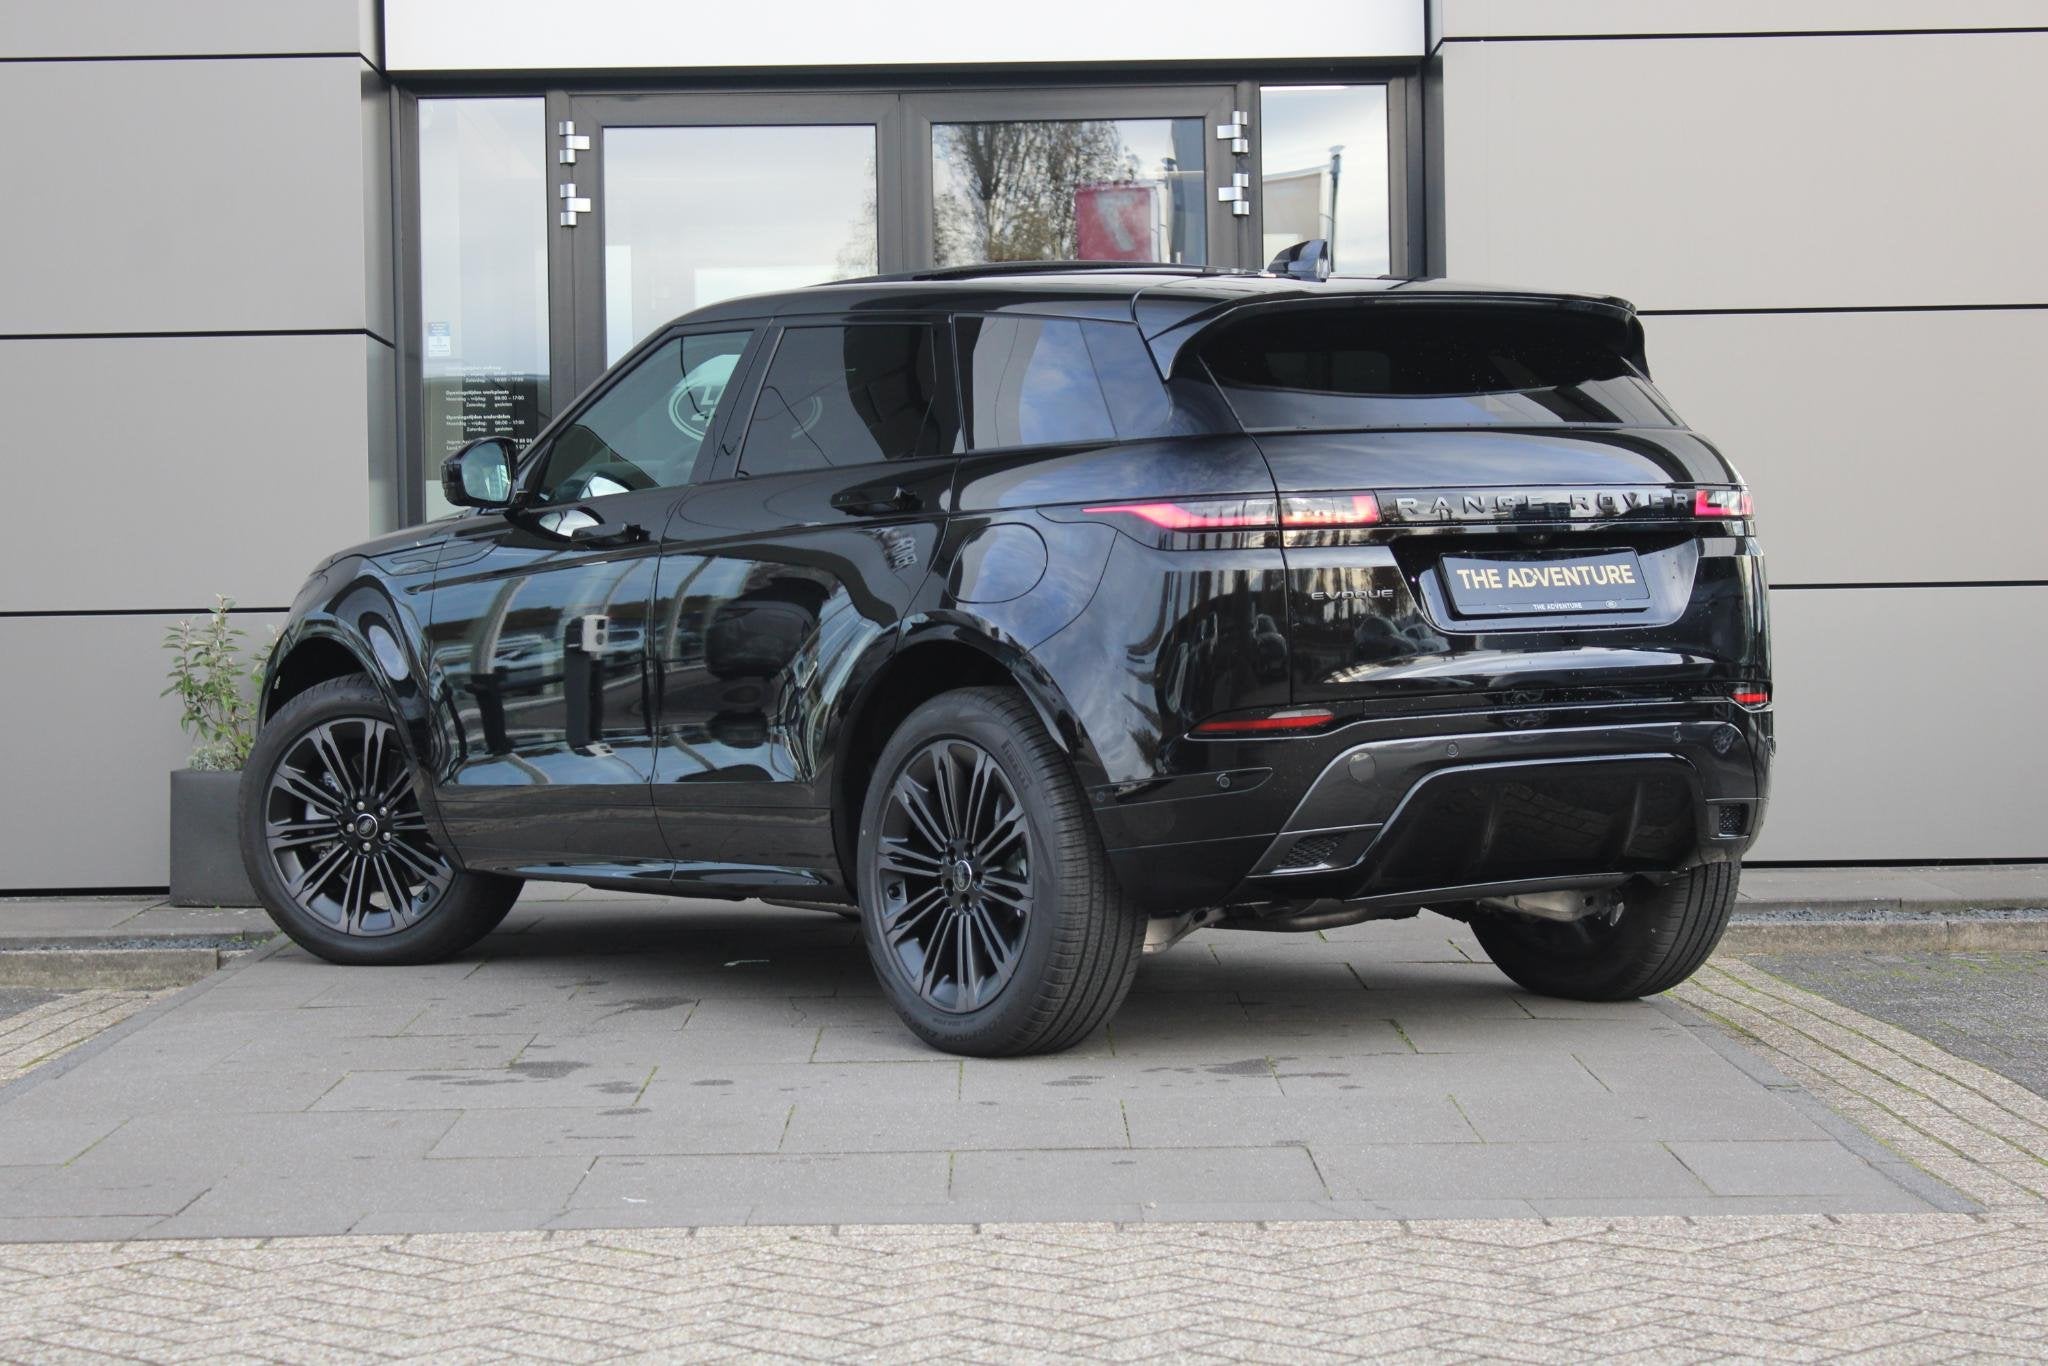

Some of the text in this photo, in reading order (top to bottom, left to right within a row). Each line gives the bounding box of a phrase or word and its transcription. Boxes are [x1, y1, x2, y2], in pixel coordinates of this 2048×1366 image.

[1394, 491, 1689, 515] RANGE ROVER
[1456, 564, 1636, 590] THE ADVENTURE
[1311, 589, 1394, 601] EVOQUE
[1532, 602, 1583, 611] THE ADVENTURE
